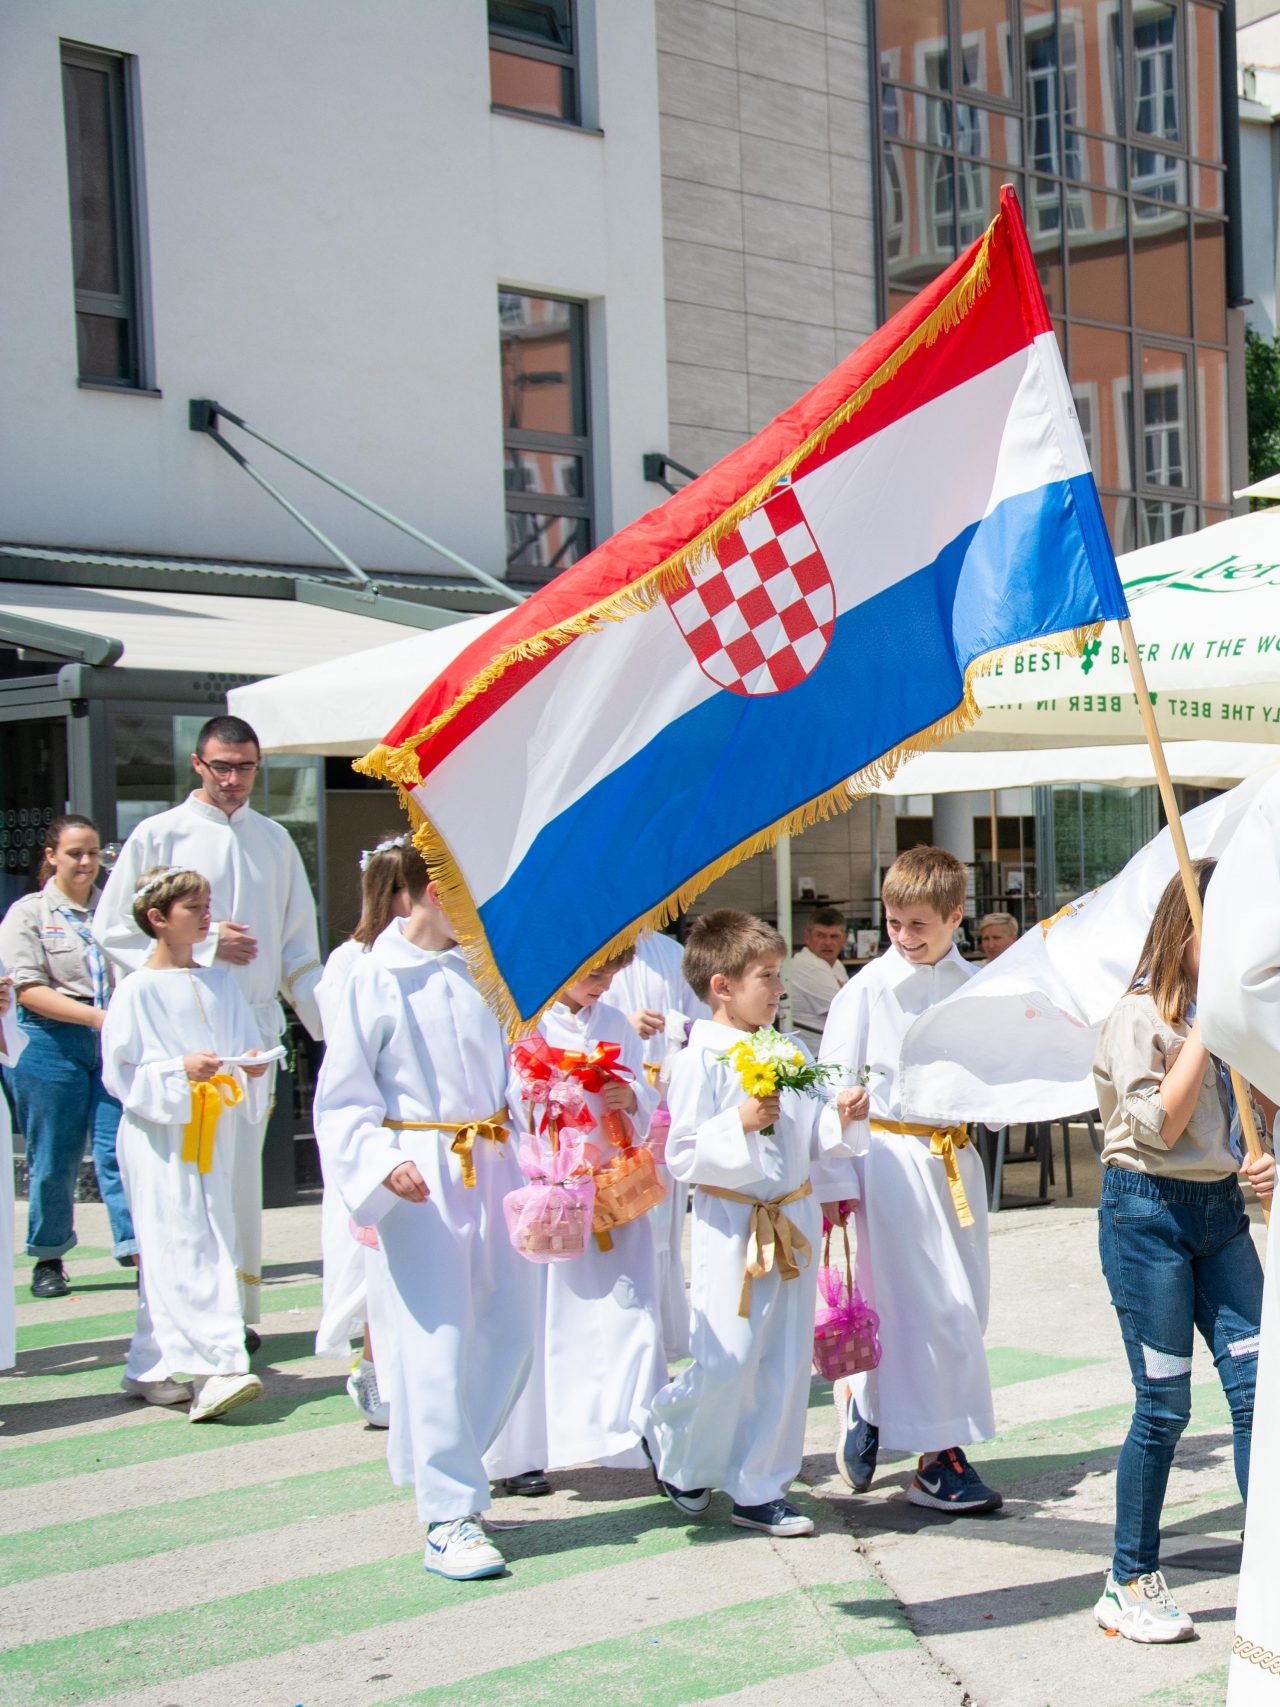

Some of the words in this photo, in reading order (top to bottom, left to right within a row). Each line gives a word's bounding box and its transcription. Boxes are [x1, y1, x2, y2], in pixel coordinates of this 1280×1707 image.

[1170, 642, 1195, 661] IN
[1205, 638, 1247, 659] THE
[1014, 651, 1062, 675] BEST
